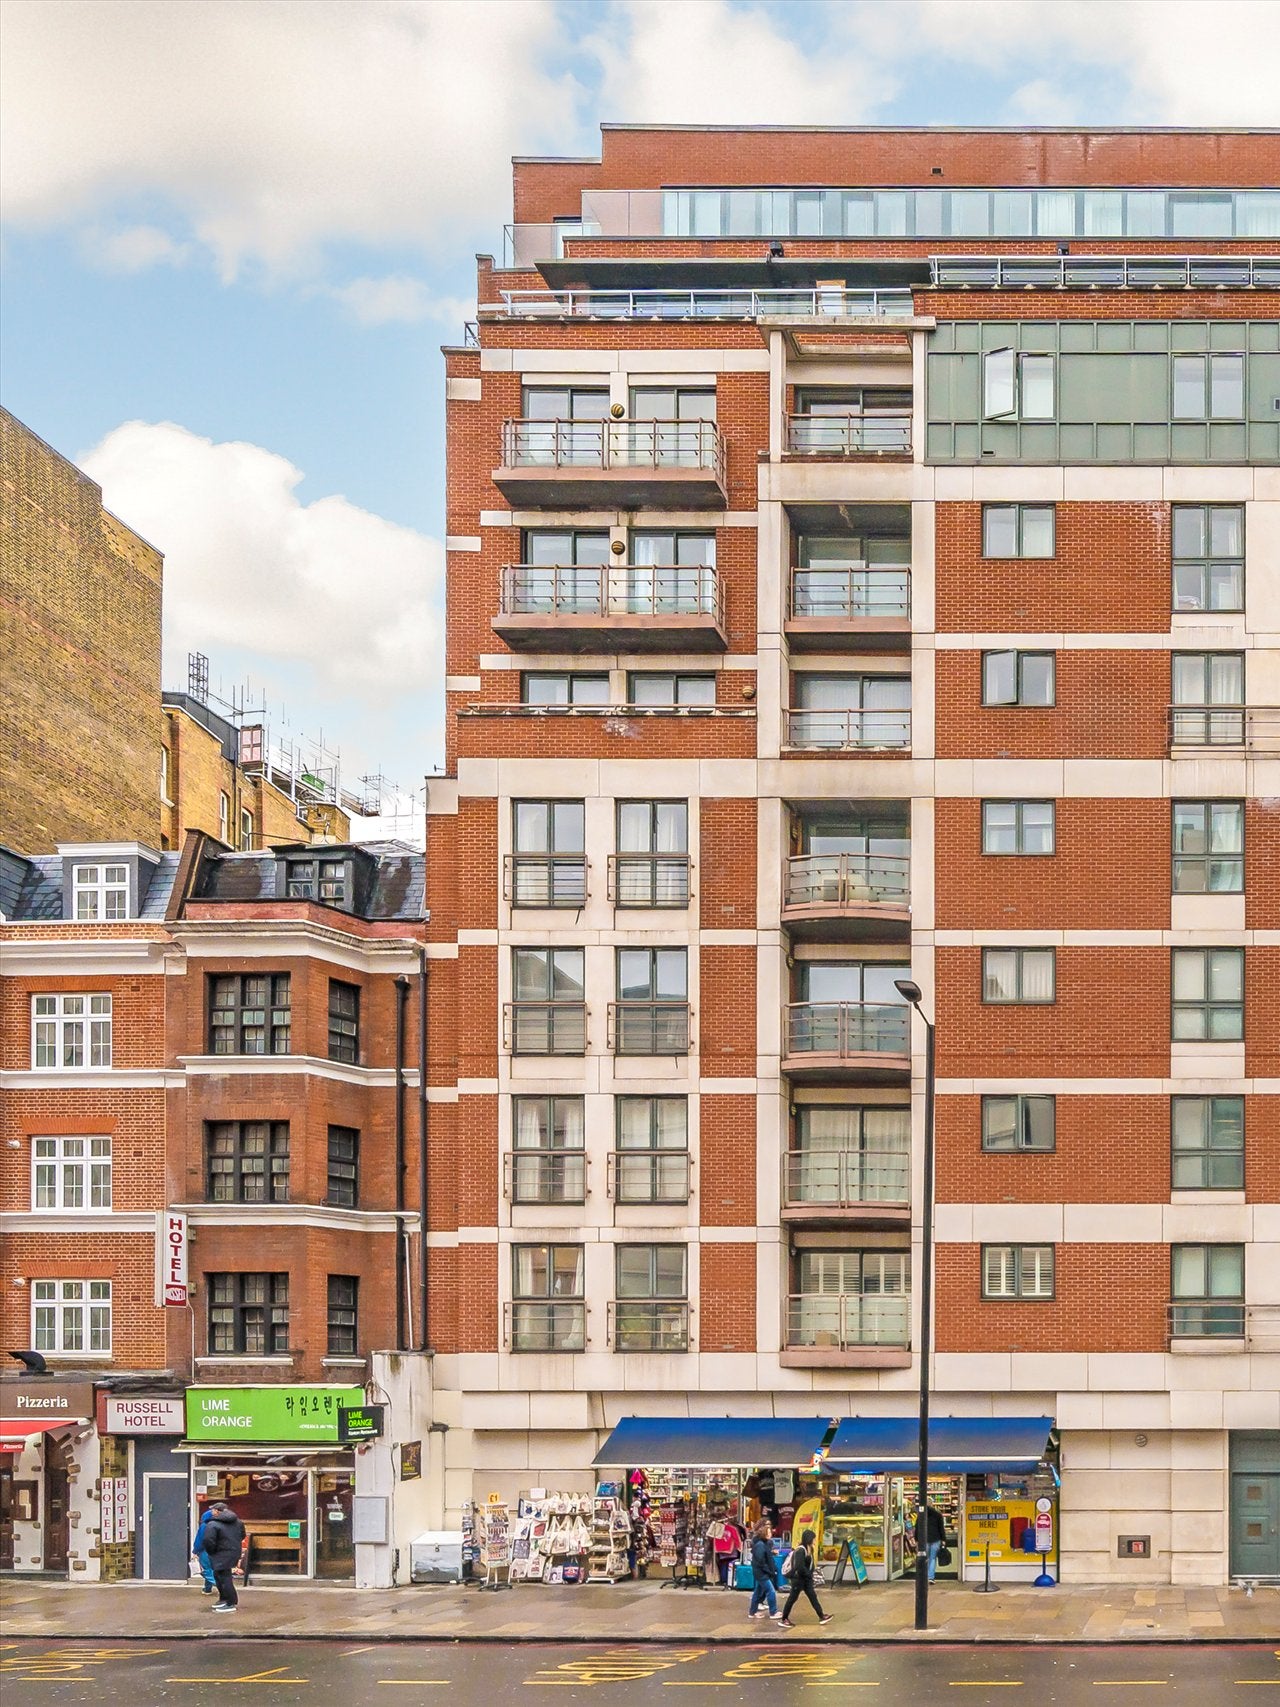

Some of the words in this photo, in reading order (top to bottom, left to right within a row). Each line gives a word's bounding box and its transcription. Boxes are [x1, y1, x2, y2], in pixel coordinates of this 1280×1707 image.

[169, 1218, 183, 1282] HOTEL
[17, 1396, 68, 1408] Pizzeria
[201, 1399, 230, 1411] LIME
[116, 1403, 173, 1414] RUSSELL
[124, 1415, 166, 1427] HOTEL
[348, 1411, 362, 1419] LIME
[202, 1416, 252, 1428] ORANGE
[348, 1419, 373, 1427] ORANGE
[490, 1494, 497, 1502] £1
[103, 1481, 111, 1541] HOTEL
[117, 1480, 126, 1540] HOTEL
